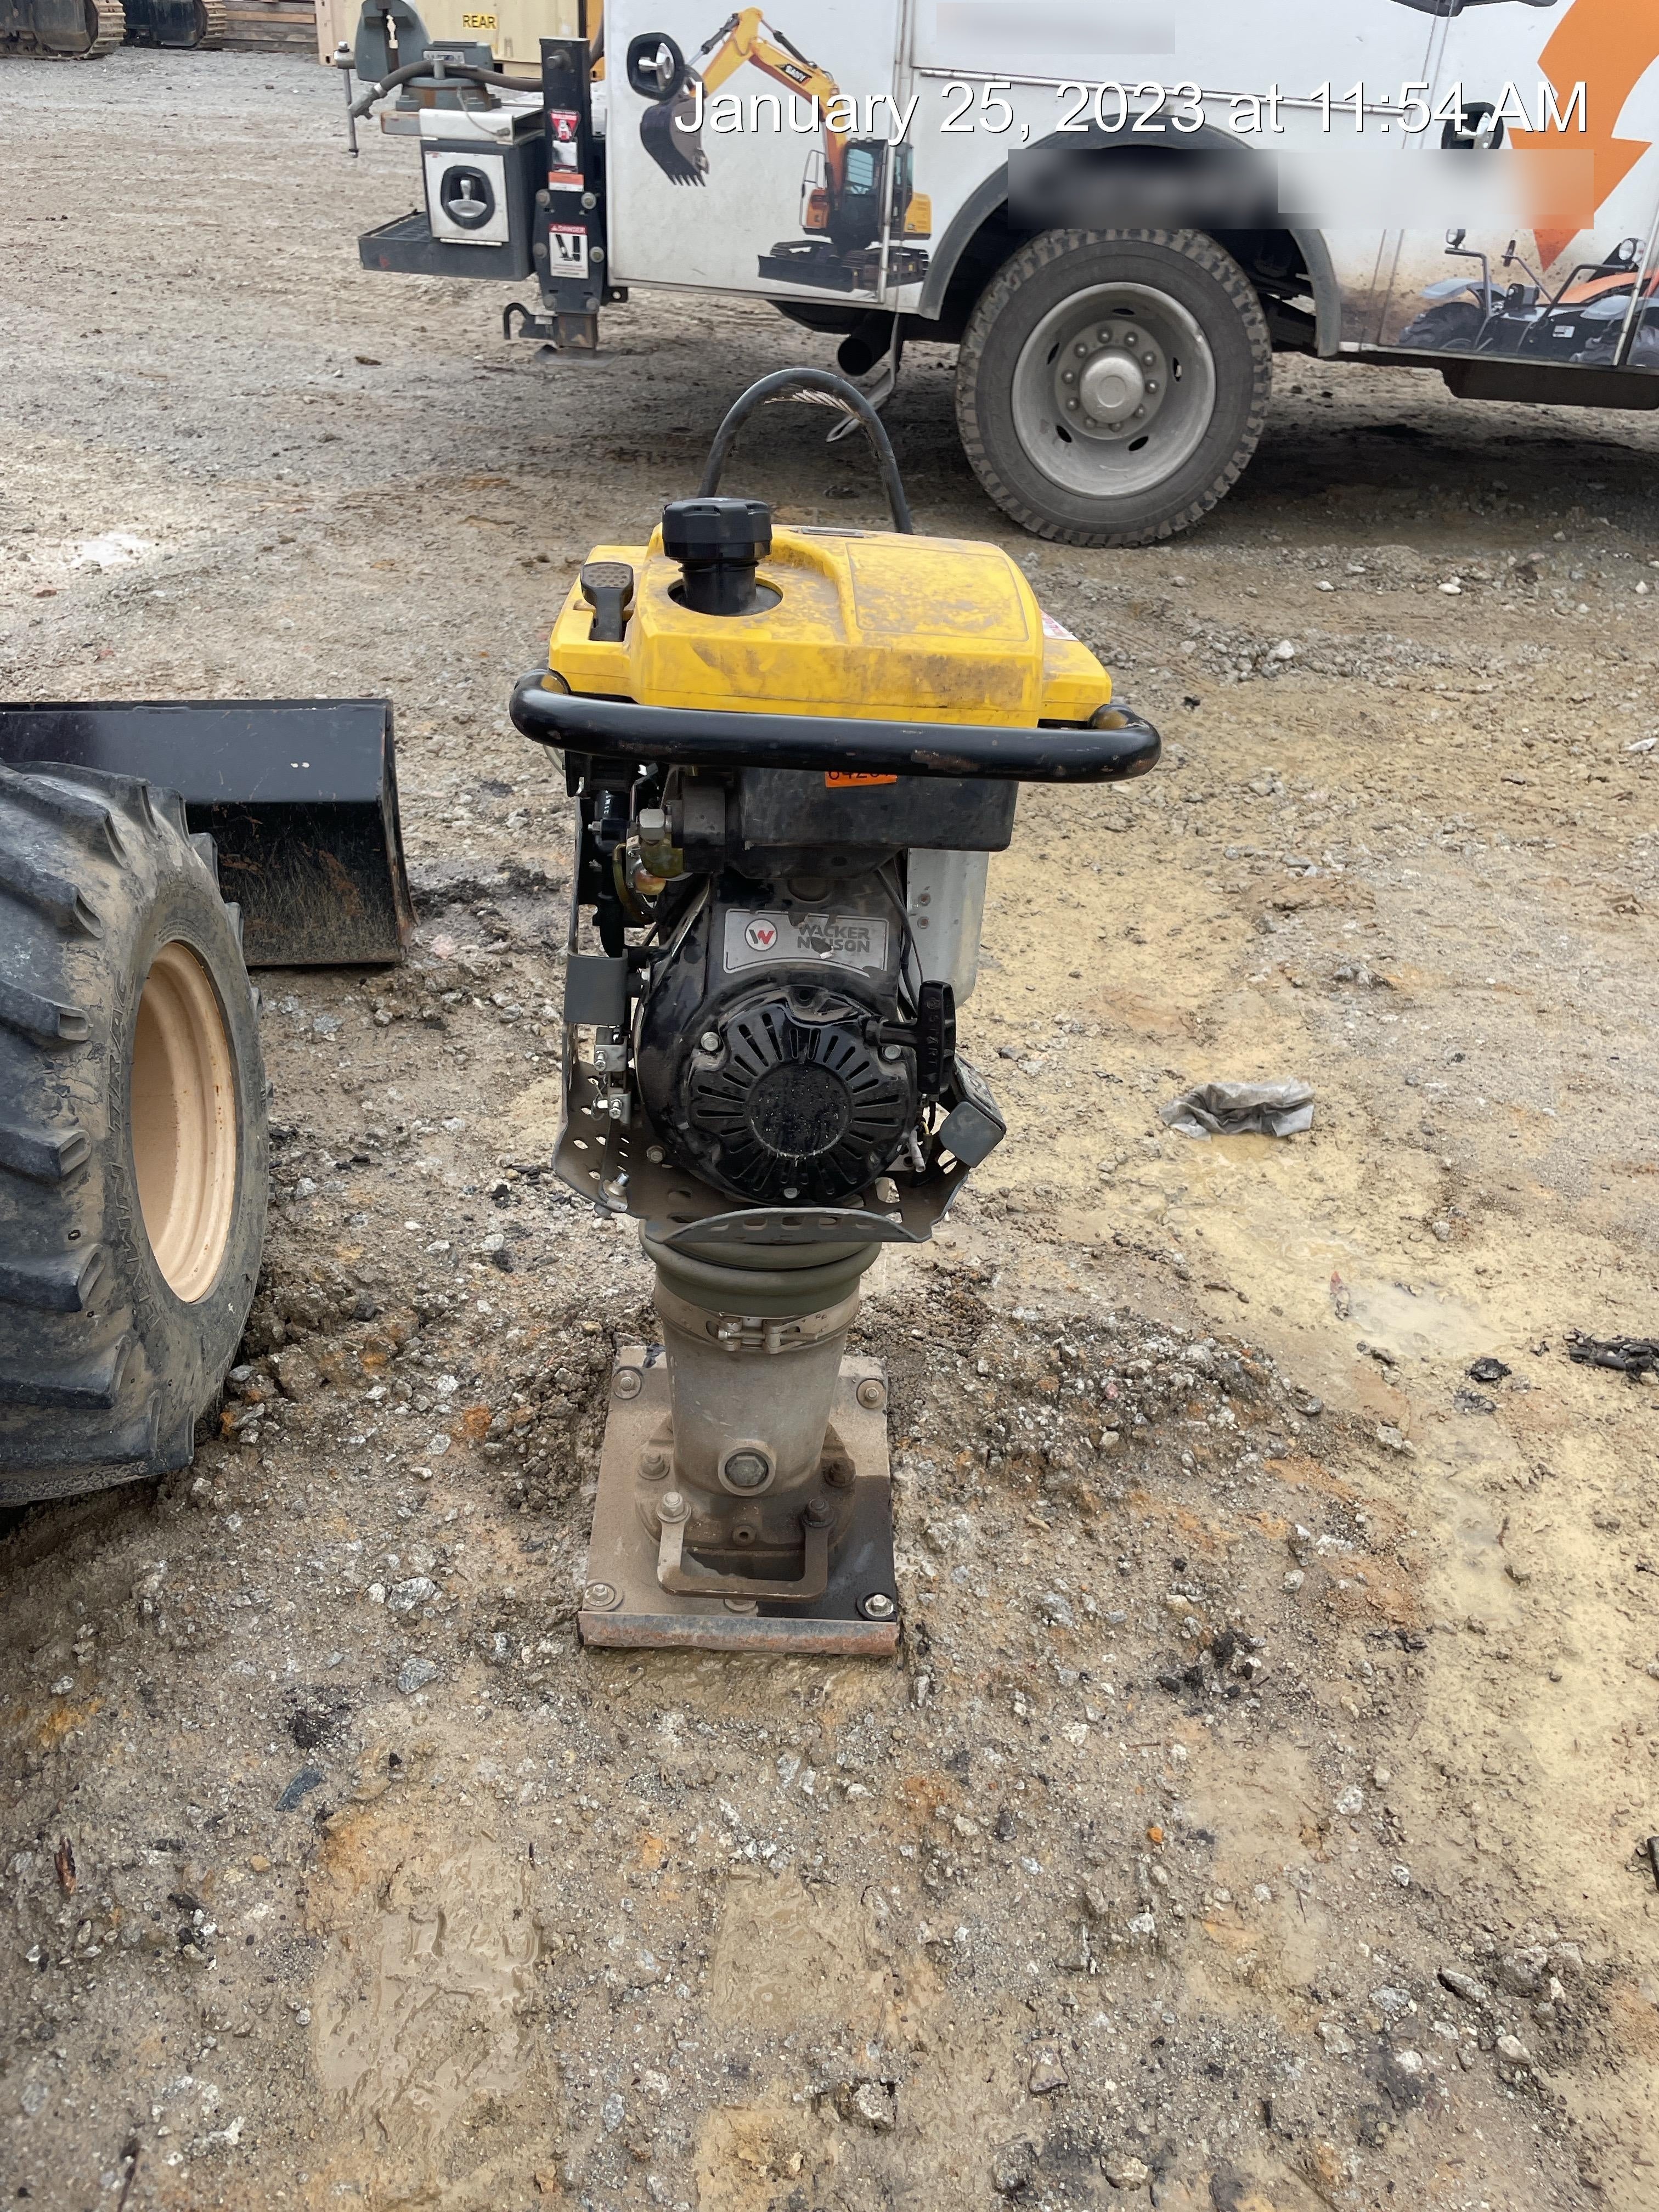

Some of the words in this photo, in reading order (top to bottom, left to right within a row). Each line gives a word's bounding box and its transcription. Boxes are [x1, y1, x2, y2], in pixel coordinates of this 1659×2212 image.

[462, 15, 496, 29] REAR
[798, 923, 870, 940] WACKER
[797, 936, 871, 953] NSON
